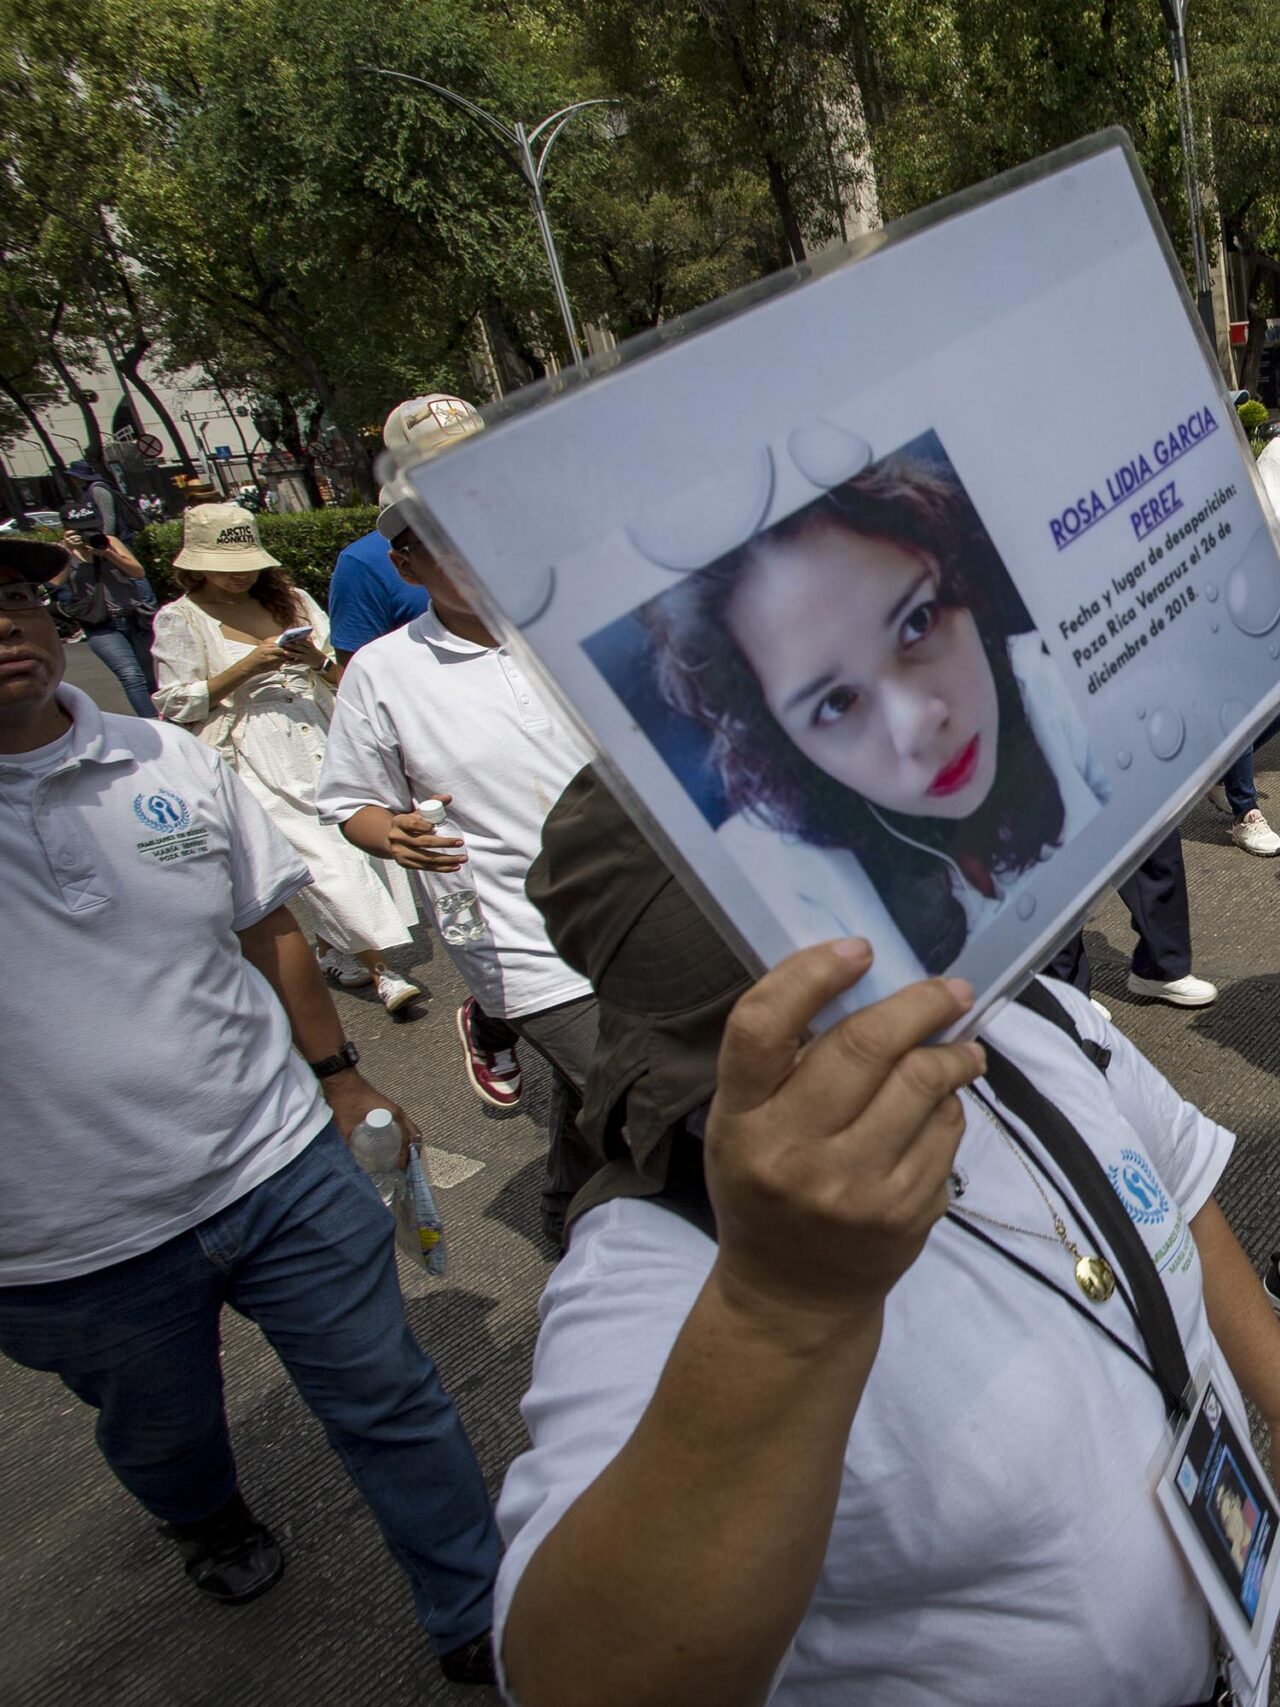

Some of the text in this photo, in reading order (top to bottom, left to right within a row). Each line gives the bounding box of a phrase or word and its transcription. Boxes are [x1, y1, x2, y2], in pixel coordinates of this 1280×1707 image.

[219, 525, 252, 538] ARCTIC
[1049, 405, 1219, 549] ROSA LIDIA GARCIA
[1129, 480, 1184, 541] PEREZ
[1058, 483, 1238, 640] Fecha y lugar de desaparición:
[1071, 521, 1233, 668] Poza Rica Veracruz el 26 de
[1086, 585, 1200, 696] diciembre de 2018.
